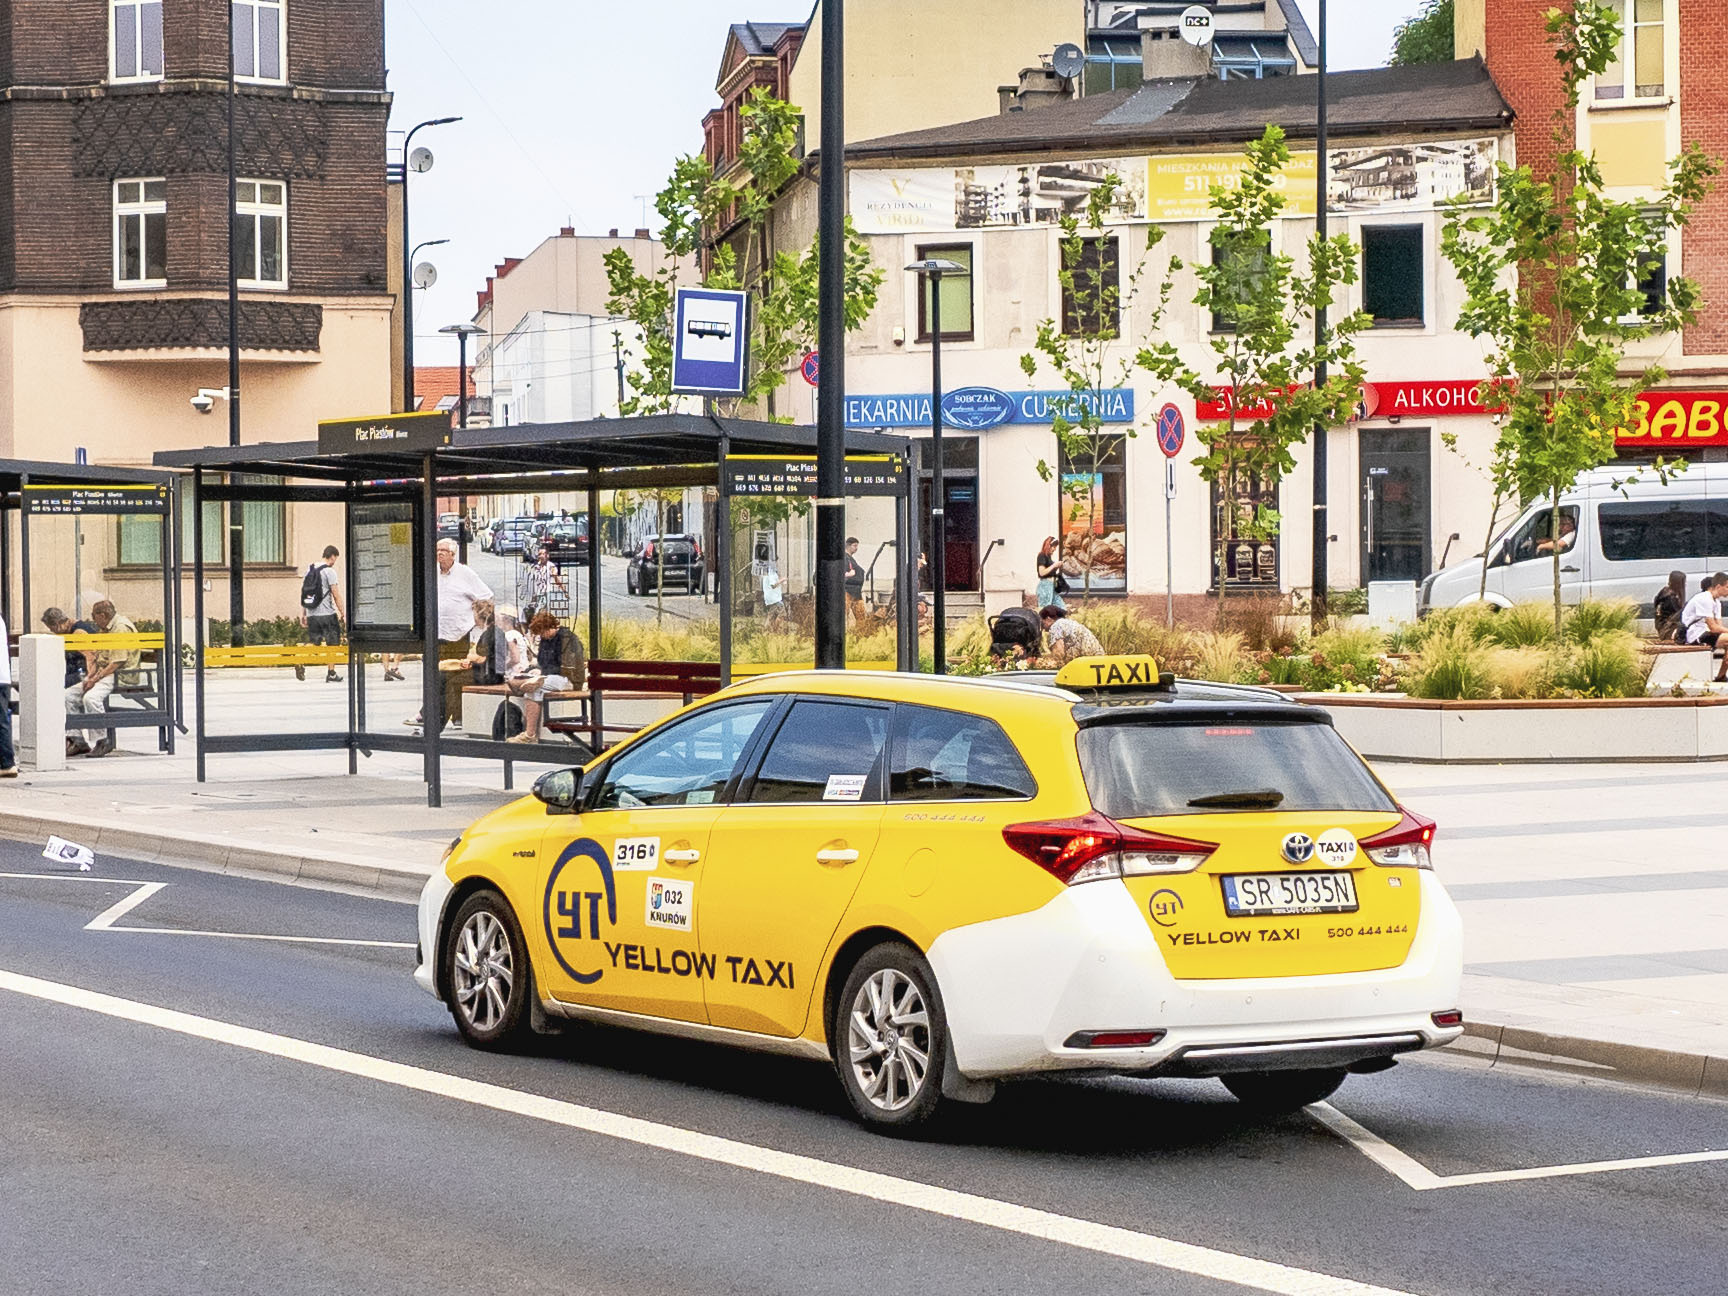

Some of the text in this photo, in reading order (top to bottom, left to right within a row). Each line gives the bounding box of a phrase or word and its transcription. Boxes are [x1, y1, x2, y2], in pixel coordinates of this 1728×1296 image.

[1184, 176, 1210, 191] 511
[954, 393, 996, 404] SOBCZAK
[1394, 387, 1482, 408] ALKOHO
[843, 398, 933, 424] IEKARNIA
[1090, 662, 1151, 684] TAXI
[617, 843, 647, 860] 316
[1318, 842, 1347, 853] TAXI
[664, 889, 683, 904] 032
[1241, 875, 1350, 906] SR 5035N
[650, 910, 687, 926] KNURÓW
[1168, 924, 1409, 946] YELLOW TAXI 500 444 444
[603, 941, 795, 989] YELLOW TAXI
